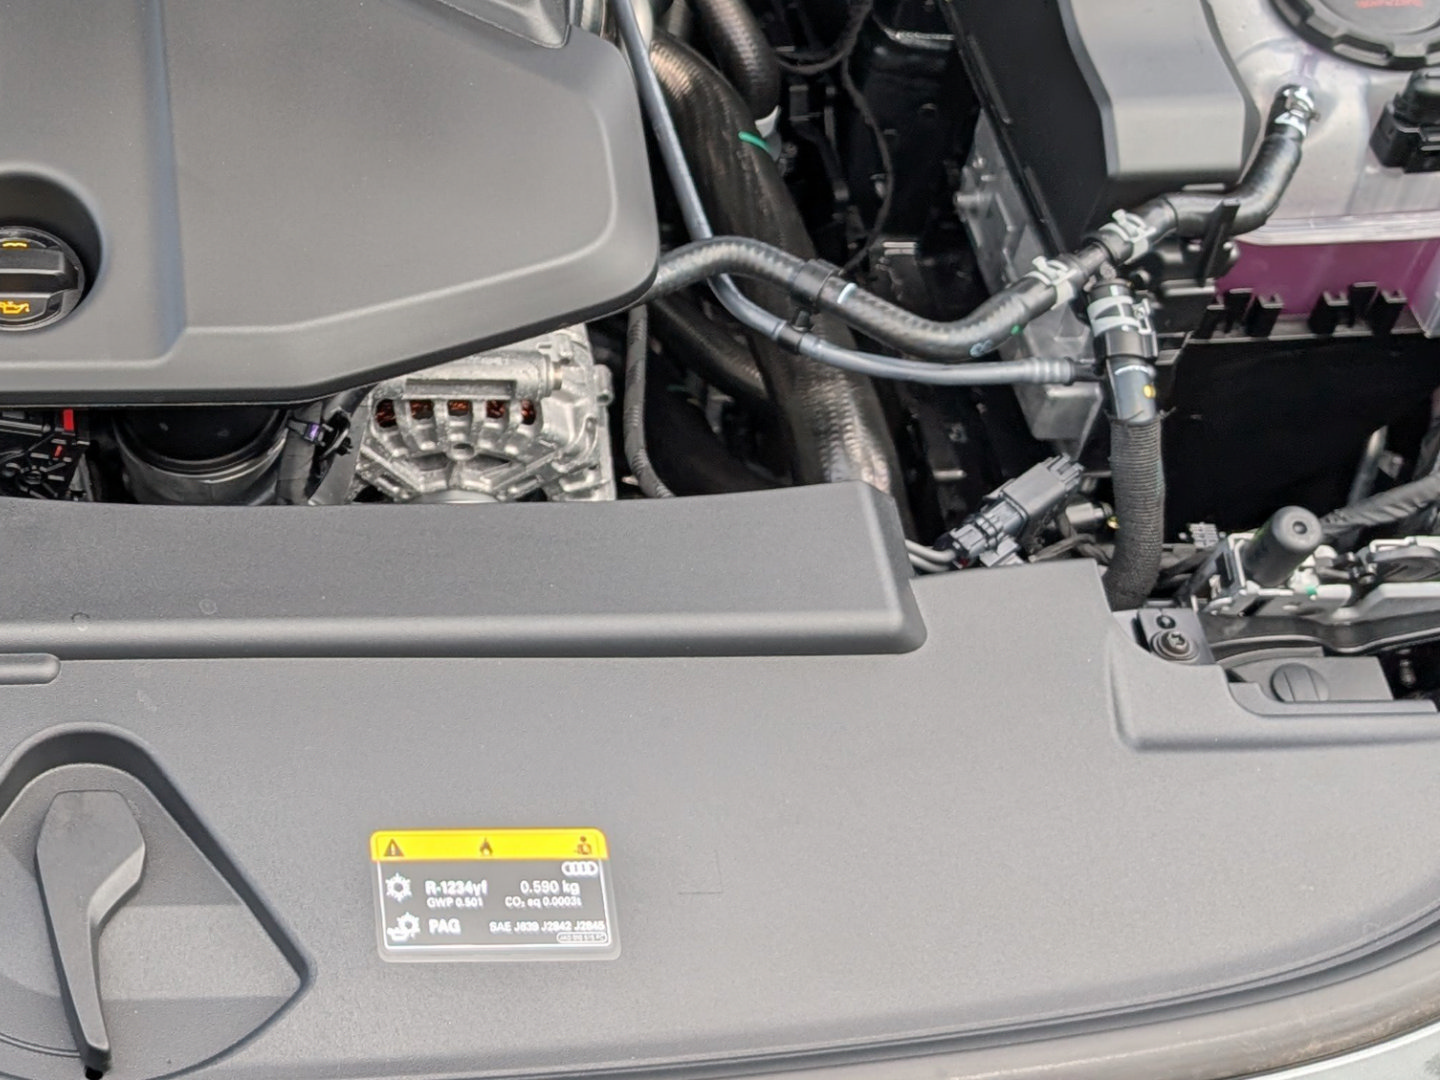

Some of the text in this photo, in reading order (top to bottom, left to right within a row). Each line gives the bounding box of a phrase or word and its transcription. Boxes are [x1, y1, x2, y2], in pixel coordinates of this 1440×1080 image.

[425, 879, 488, 896] R-1234yf
[520, 880, 580, 896] 0.590 kg
[426, 896, 483, 908] GWP 0.501
[527, 898, 542, 908] eq
[428, 919, 461, 933] PAG
[489, 921, 511, 932] SAE
